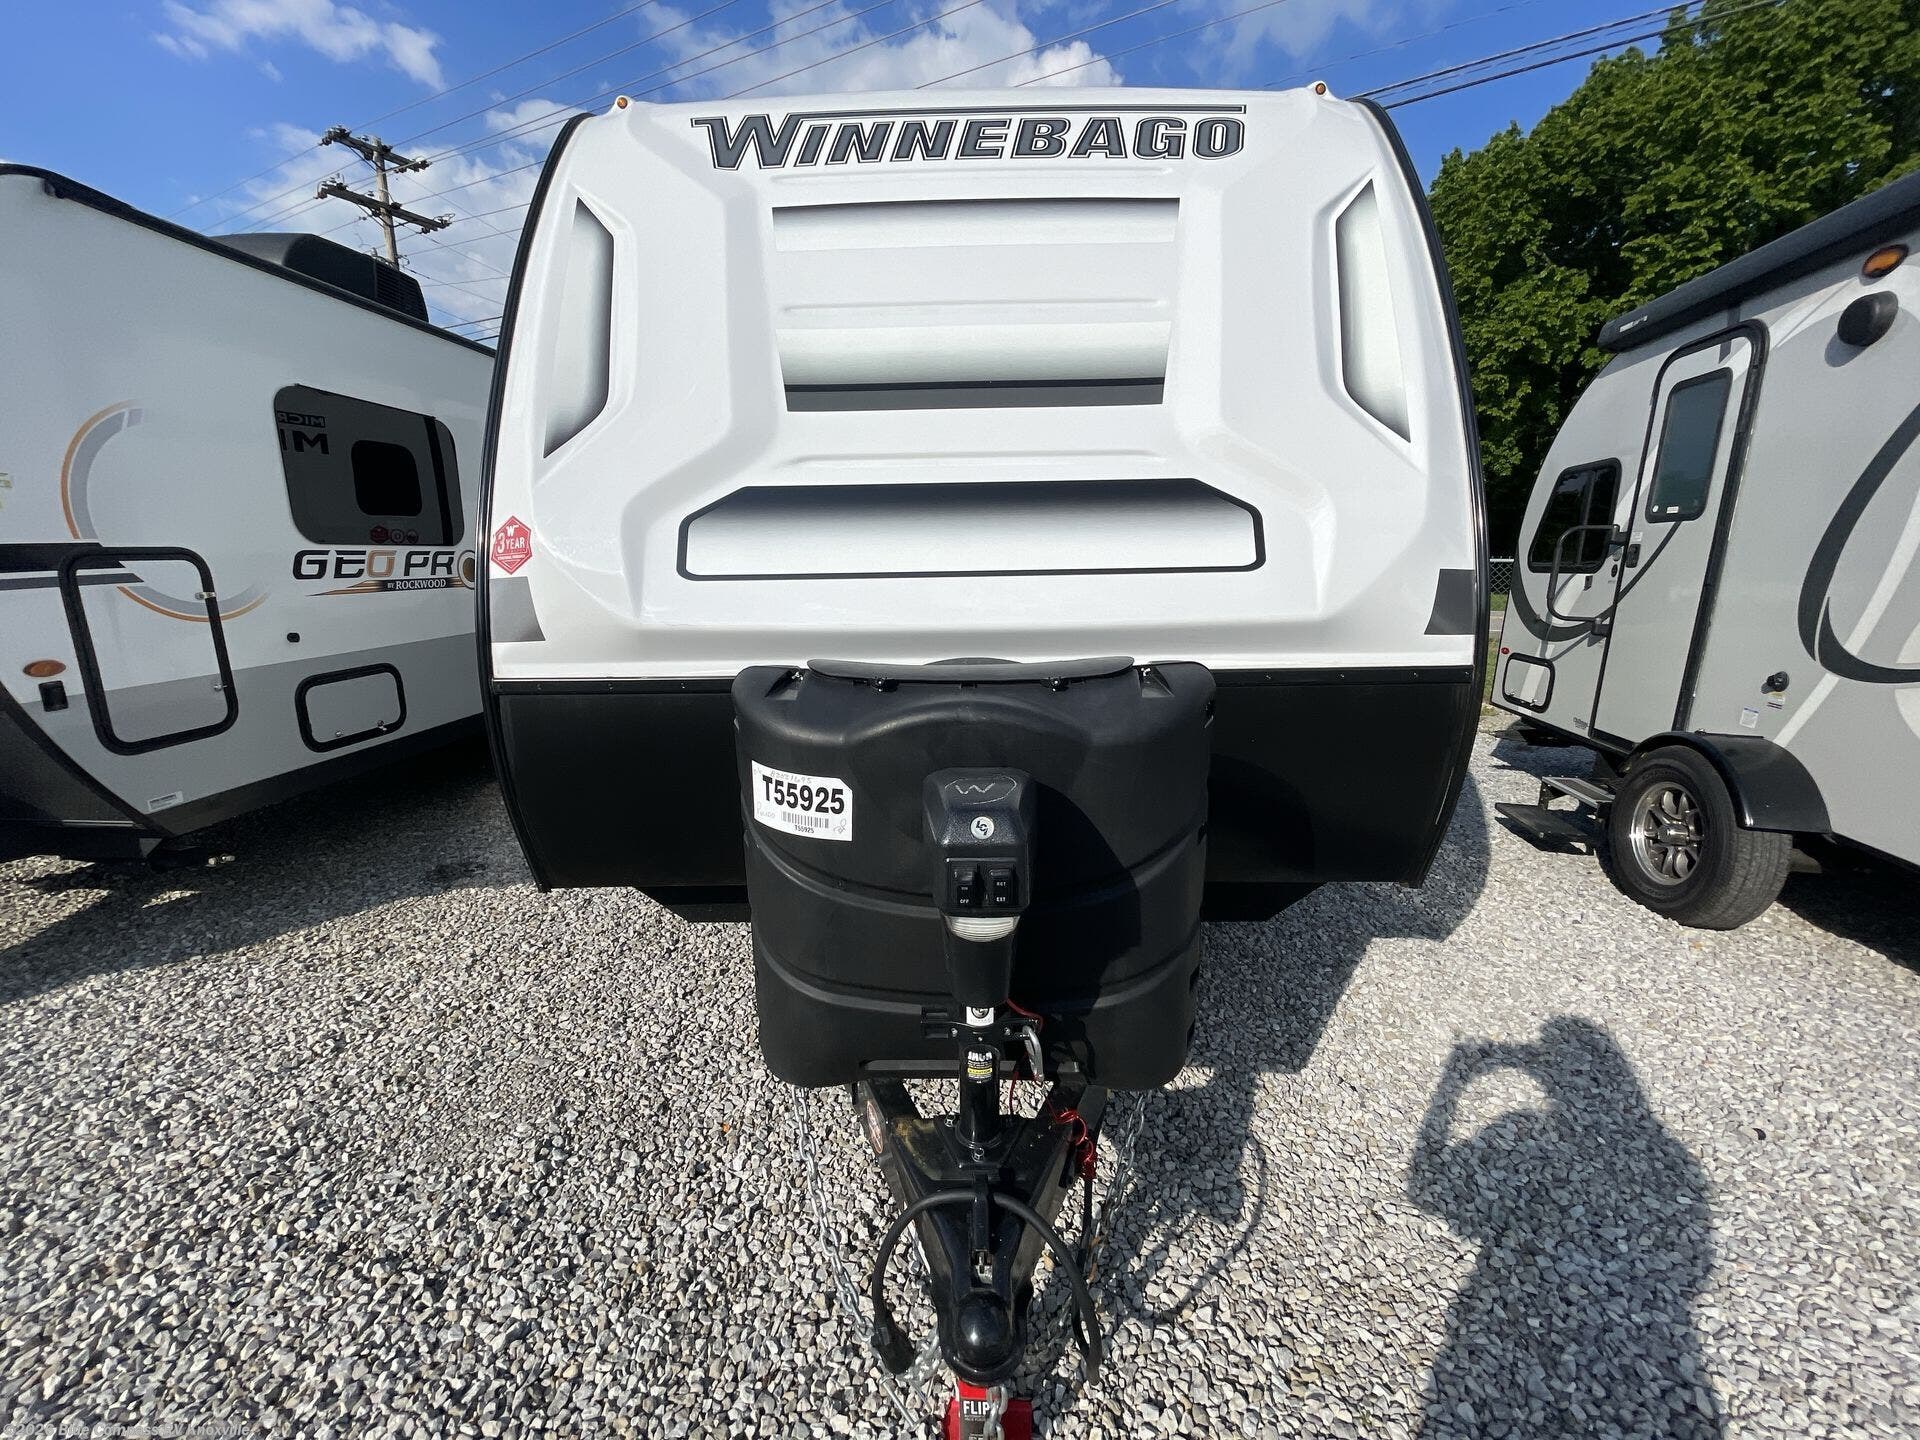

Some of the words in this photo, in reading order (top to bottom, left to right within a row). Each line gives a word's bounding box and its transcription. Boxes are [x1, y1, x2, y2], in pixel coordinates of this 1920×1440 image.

[497, 532, 506, 554] 3
[506, 537, 526, 550] YEAR
[292, 550, 397, 580] GEO
[395, 578, 447, 590] ROCKWOOD
[762, 774, 845, 815] T55925
[794, 824, 815, 834] T55925
[963, 1400, 990, 1415] FLIP
